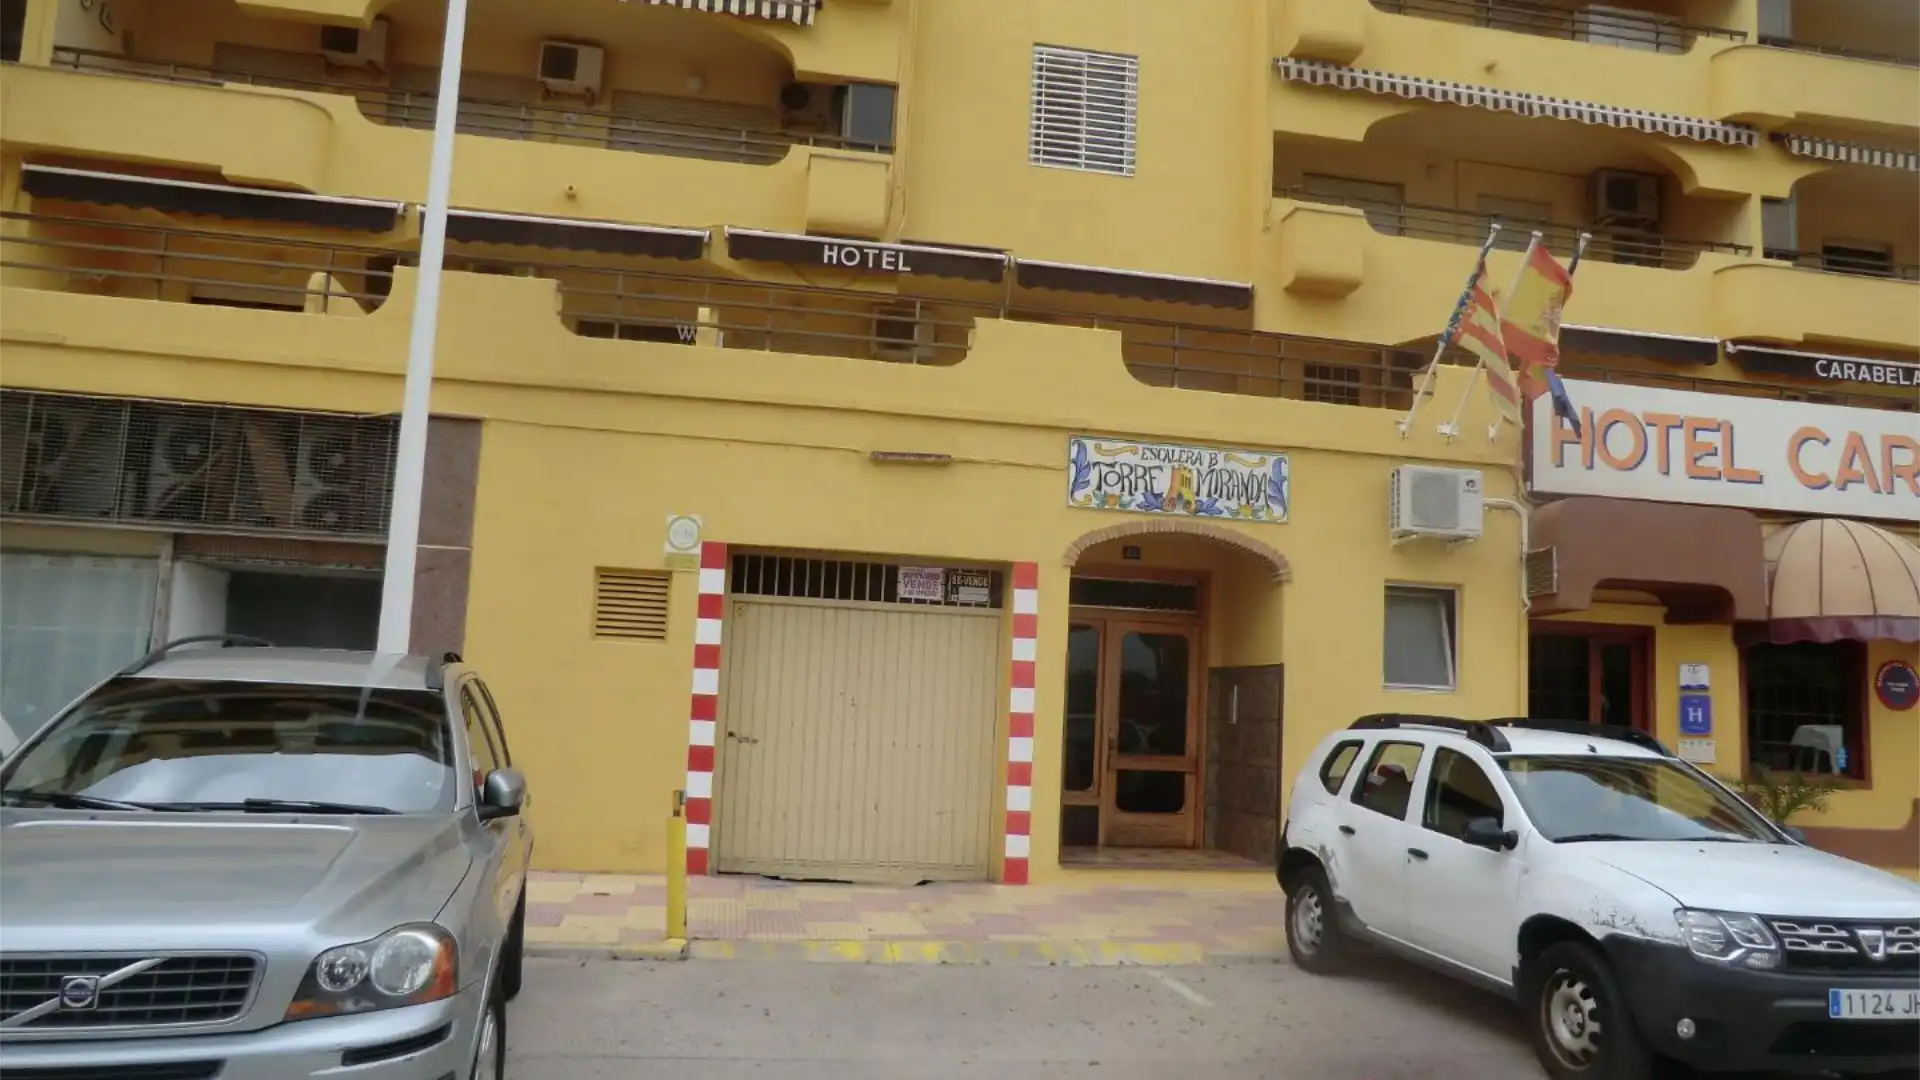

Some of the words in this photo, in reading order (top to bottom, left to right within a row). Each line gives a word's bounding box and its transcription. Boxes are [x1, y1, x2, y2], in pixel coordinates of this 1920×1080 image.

[823, 244, 912, 272] HOTEL
[1815, 359, 1920, 386] CARABELA
[1140, 447, 1202, 467] ESCALERA
[1208, 451, 1219, 468] B
[1551, 406, 1764, 485] HOTEL
[1091, 461, 1164, 497] TORRE
[1195, 466, 1270, 508] MIRANDA
[1687, 707, 1703, 722] H
[1846, 992, 1895, 1015] 1124
